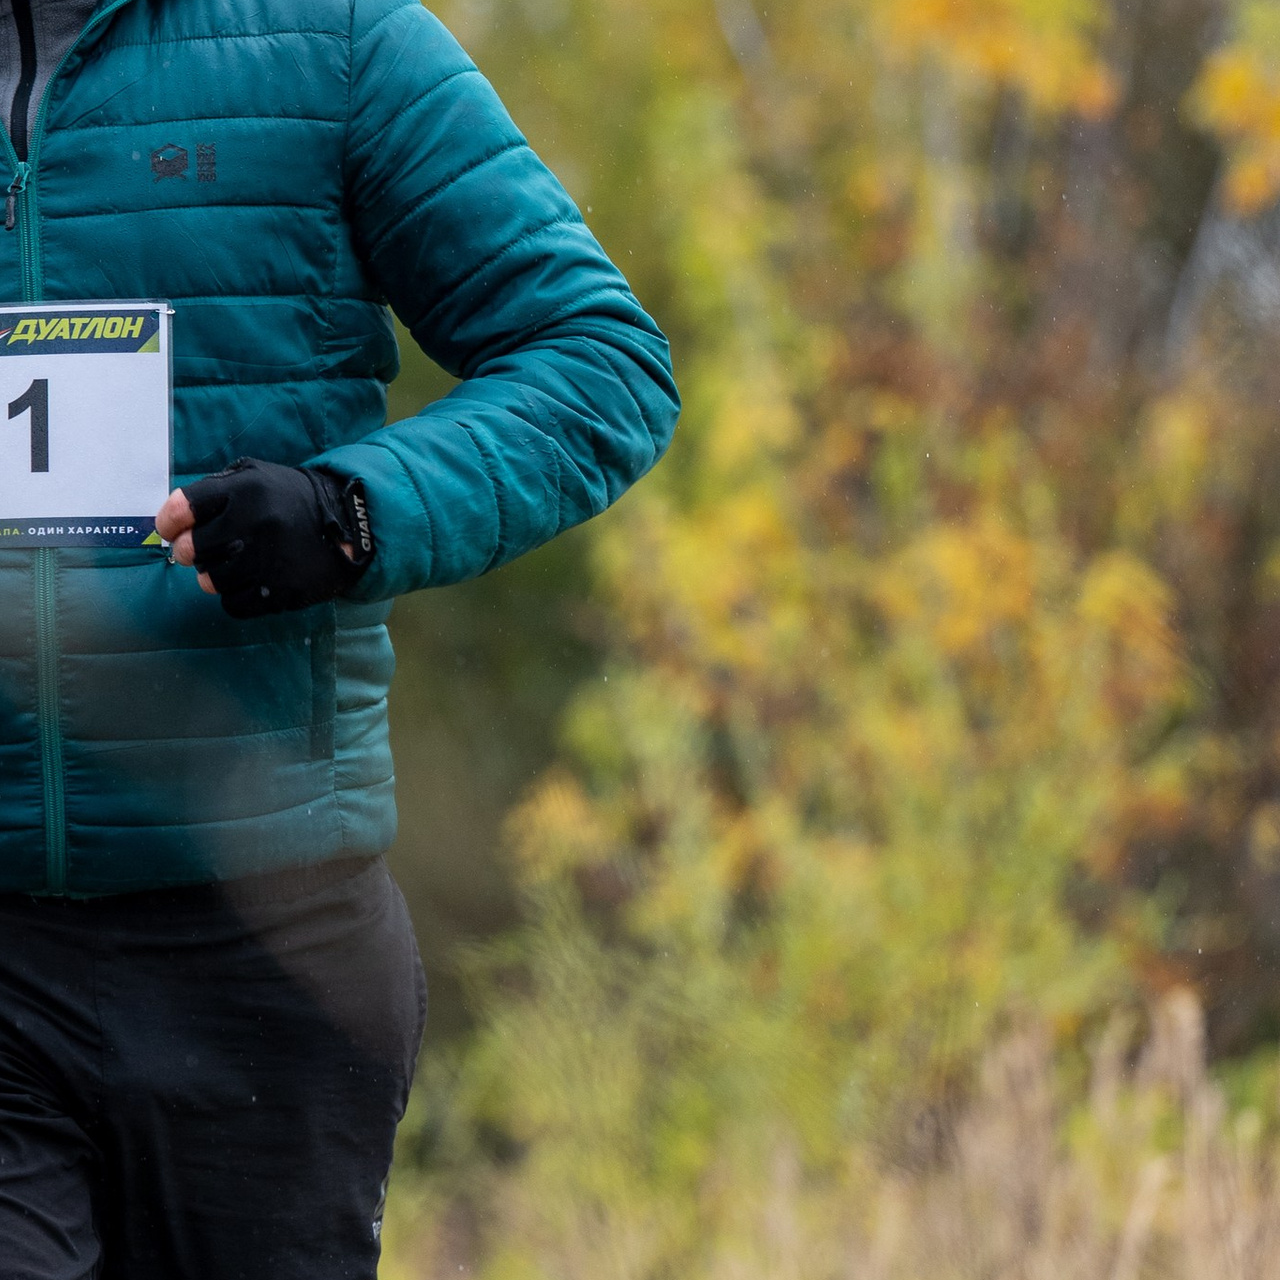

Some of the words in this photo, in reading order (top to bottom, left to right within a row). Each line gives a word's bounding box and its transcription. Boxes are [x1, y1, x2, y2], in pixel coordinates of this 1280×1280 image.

[7, 316, 144, 345] ДУАТЛОН
[28, 526, 64, 536] ОДИН
[68, 526, 139, 535] ХАРАКТЕР.
[353, 494, 371, 551] GIANT
